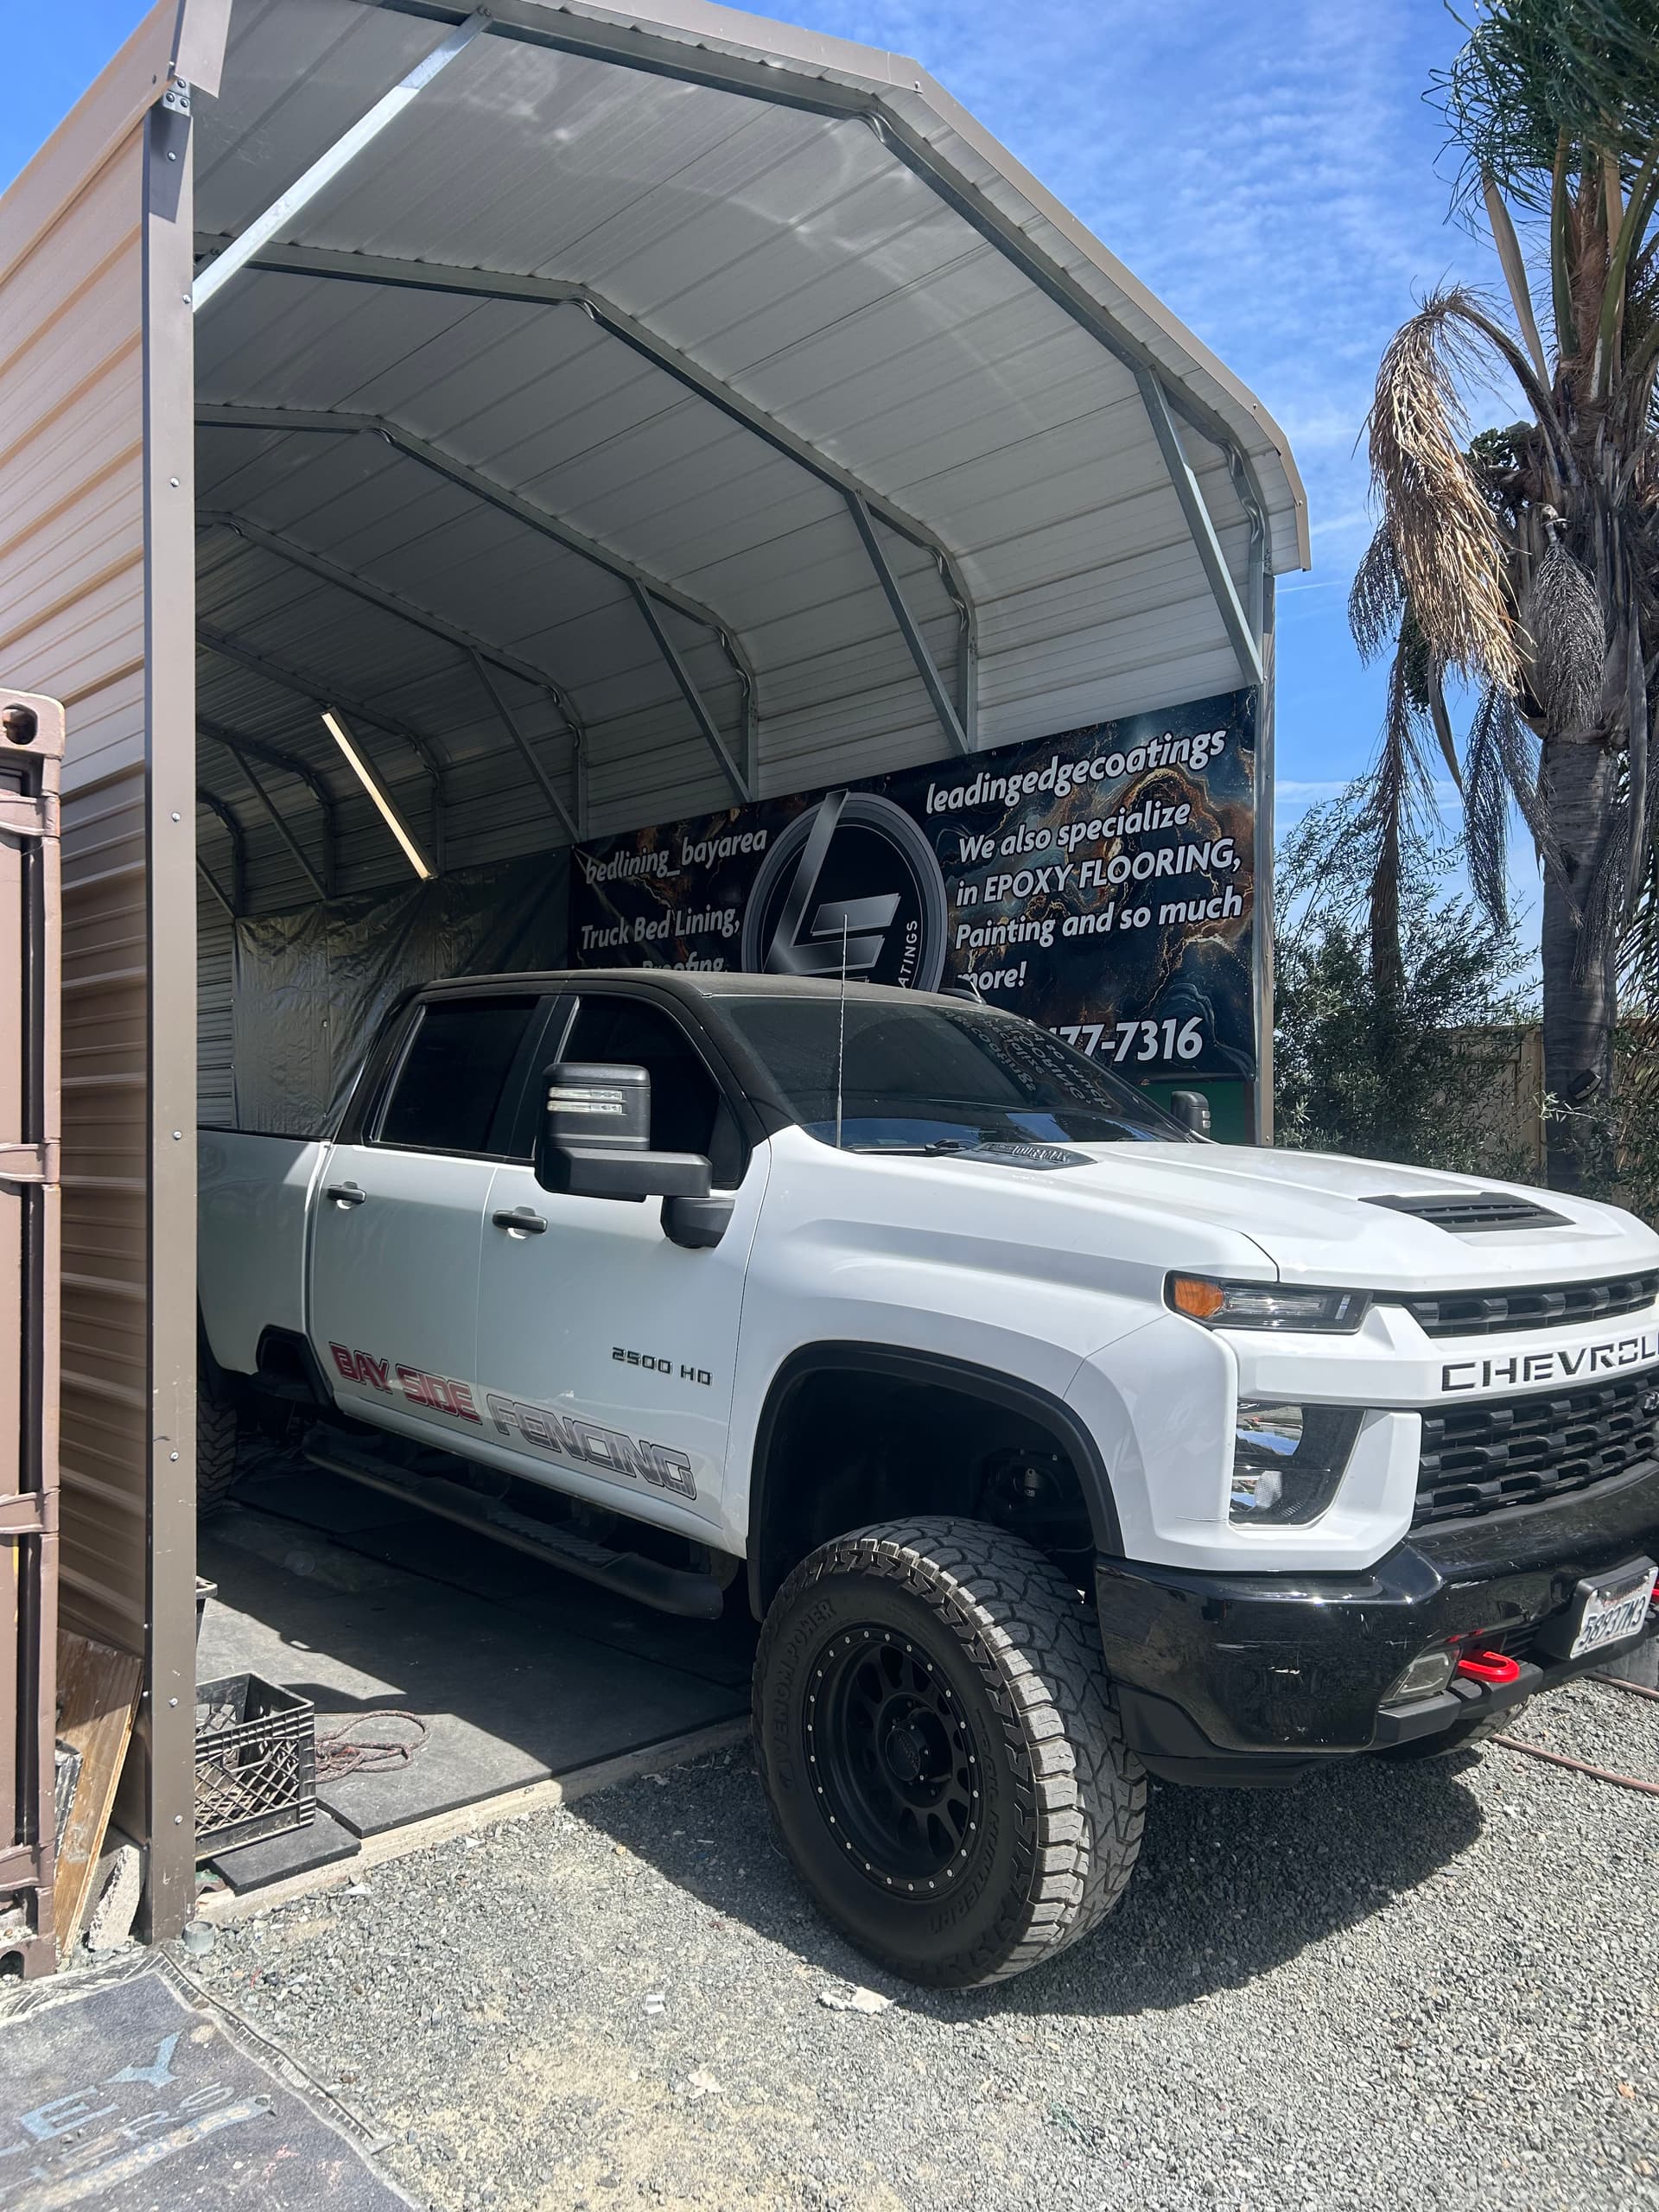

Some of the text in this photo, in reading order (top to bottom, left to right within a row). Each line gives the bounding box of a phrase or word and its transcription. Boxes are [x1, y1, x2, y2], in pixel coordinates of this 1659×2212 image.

[925, 728, 1227, 814] leadingedgecoatings
[959, 800, 1192, 863] We also specialize
[956, 838, 1242, 907] in EPOXY FLOORING,
[581, 904, 741, 950] Truck Bed Lining,
[955, 887, 1243, 950] Painting and so much
[612, 1346, 713, 1386] 2500 HD
[1441, 1332, 1659, 1392] CHEVROL
[328, 1341, 696, 1501] BAY SIDE FENCING
